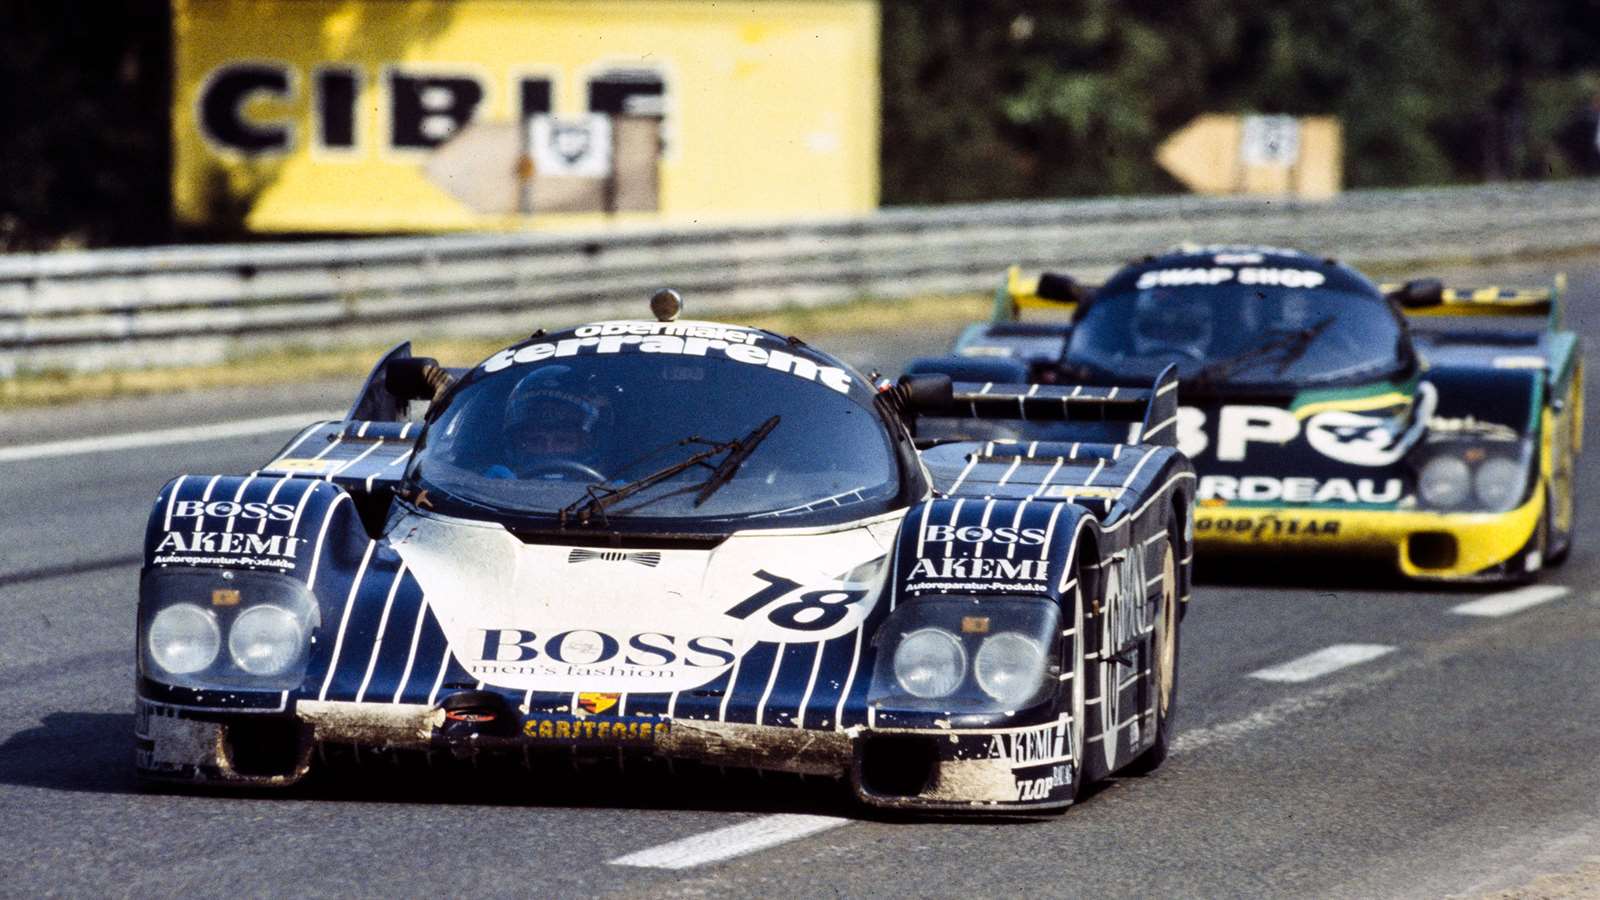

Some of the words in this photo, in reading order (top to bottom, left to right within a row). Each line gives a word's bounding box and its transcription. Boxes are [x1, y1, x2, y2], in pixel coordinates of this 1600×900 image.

[1136, 267, 1234, 289] SWAP
[1237, 267, 1325, 288] SHOP
[574, 323, 764, 345] obermaier
[480, 335, 852, 394] terrarent
[1196, 475, 1402, 503] RDEAU
[173, 500, 296, 521] BOSS
[155, 531, 299, 558] AKEMI
[924, 525, 1046, 545] BOSS
[906, 557, 1049, 581] AKEMI
[724, 569, 869, 632] 18
[476, 628, 736, 668] BOSS
[472, 664, 557, 676] men's
[566, 664, 675, 678] fashion
